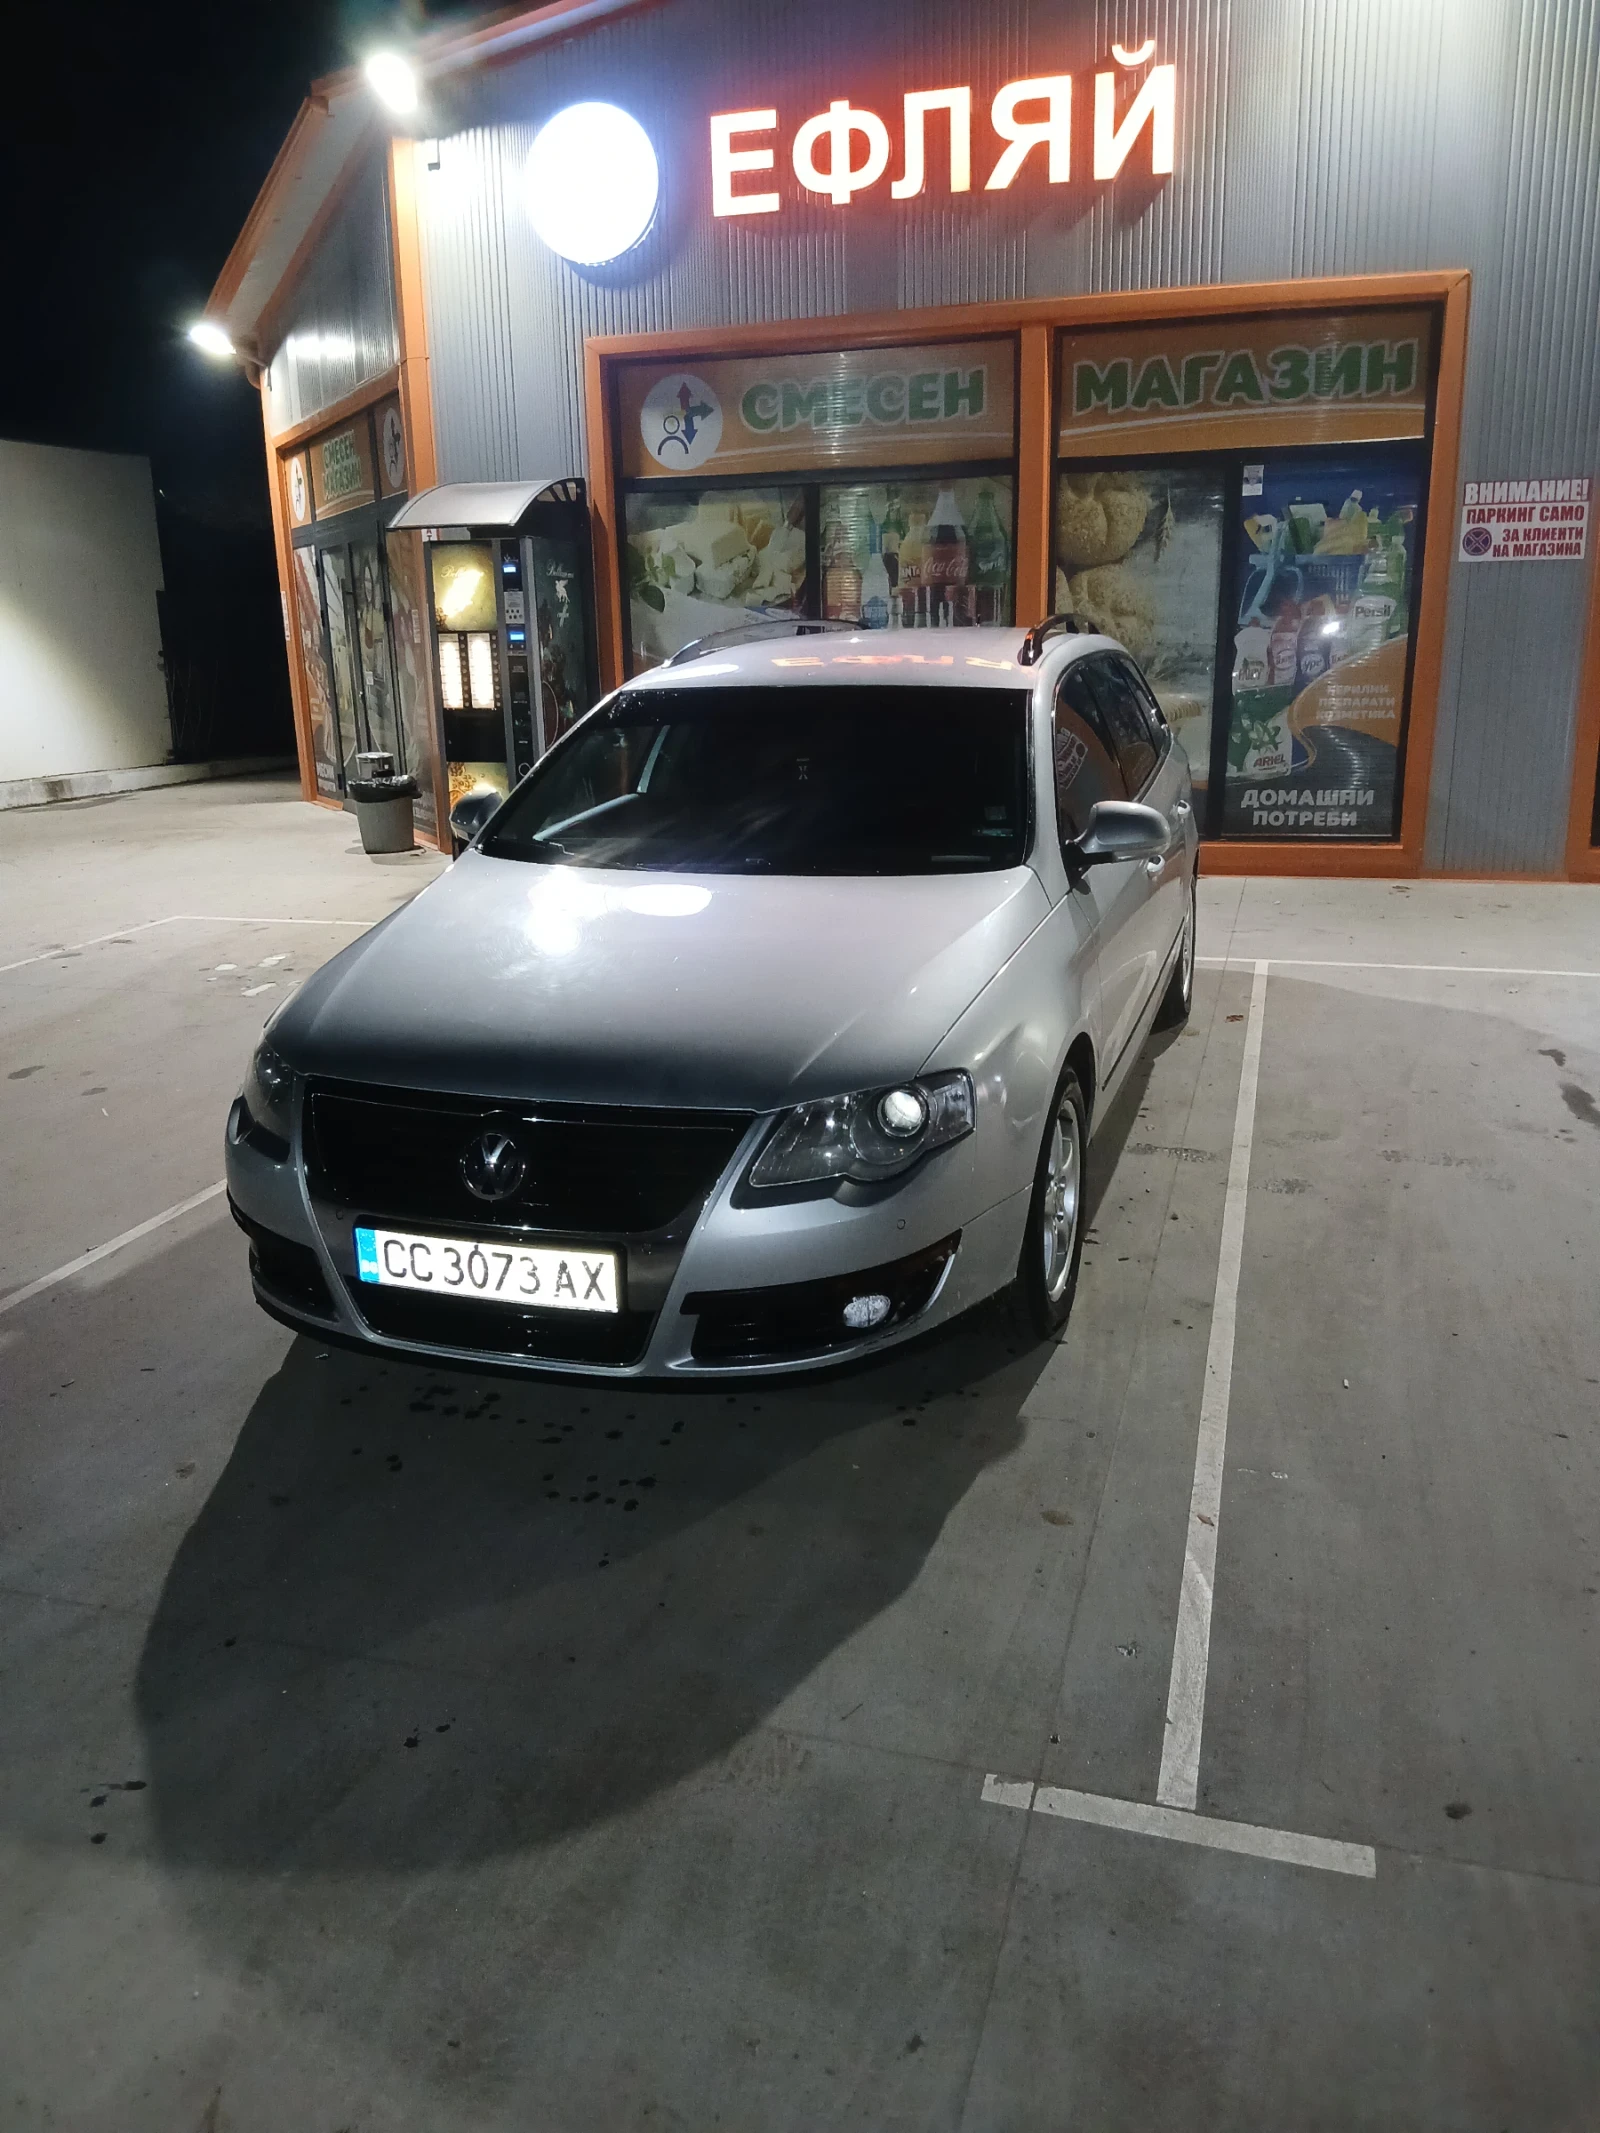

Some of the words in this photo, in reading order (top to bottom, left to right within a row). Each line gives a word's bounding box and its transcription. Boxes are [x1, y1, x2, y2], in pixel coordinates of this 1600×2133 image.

[710, 40, 1176, 218] ЕФЛЯЙ
[741, 365, 988, 433] СМЕСЕН
[1073, 340, 1418, 416] МАГАЗИН
[1465, 479, 1589, 504] ВНИМАНИЕ!
[1466, 507, 1536, 524] ПАРКИНГ
[1540, 505, 1585, 522] САМО
[1502, 529, 1520, 542] ЗА
[1523, 527, 1584, 541] КЛИЕНТИ
[1493, 545, 1509, 557] НА
[1512, 543, 1581, 557] МАГАЗИНА
[1355, 605, 1391, 618] Persil
[1254, 754, 1286, 768] ARIEL
[1241, 789, 1375, 808] ДОМАШНИ
[1252, 810, 1358, 827] ПОТРЕБИ
[383, 1239, 433, 1282] CC
[443, 1244, 541, 1294] 3073
[553, 1260, 606, 1301] AX
